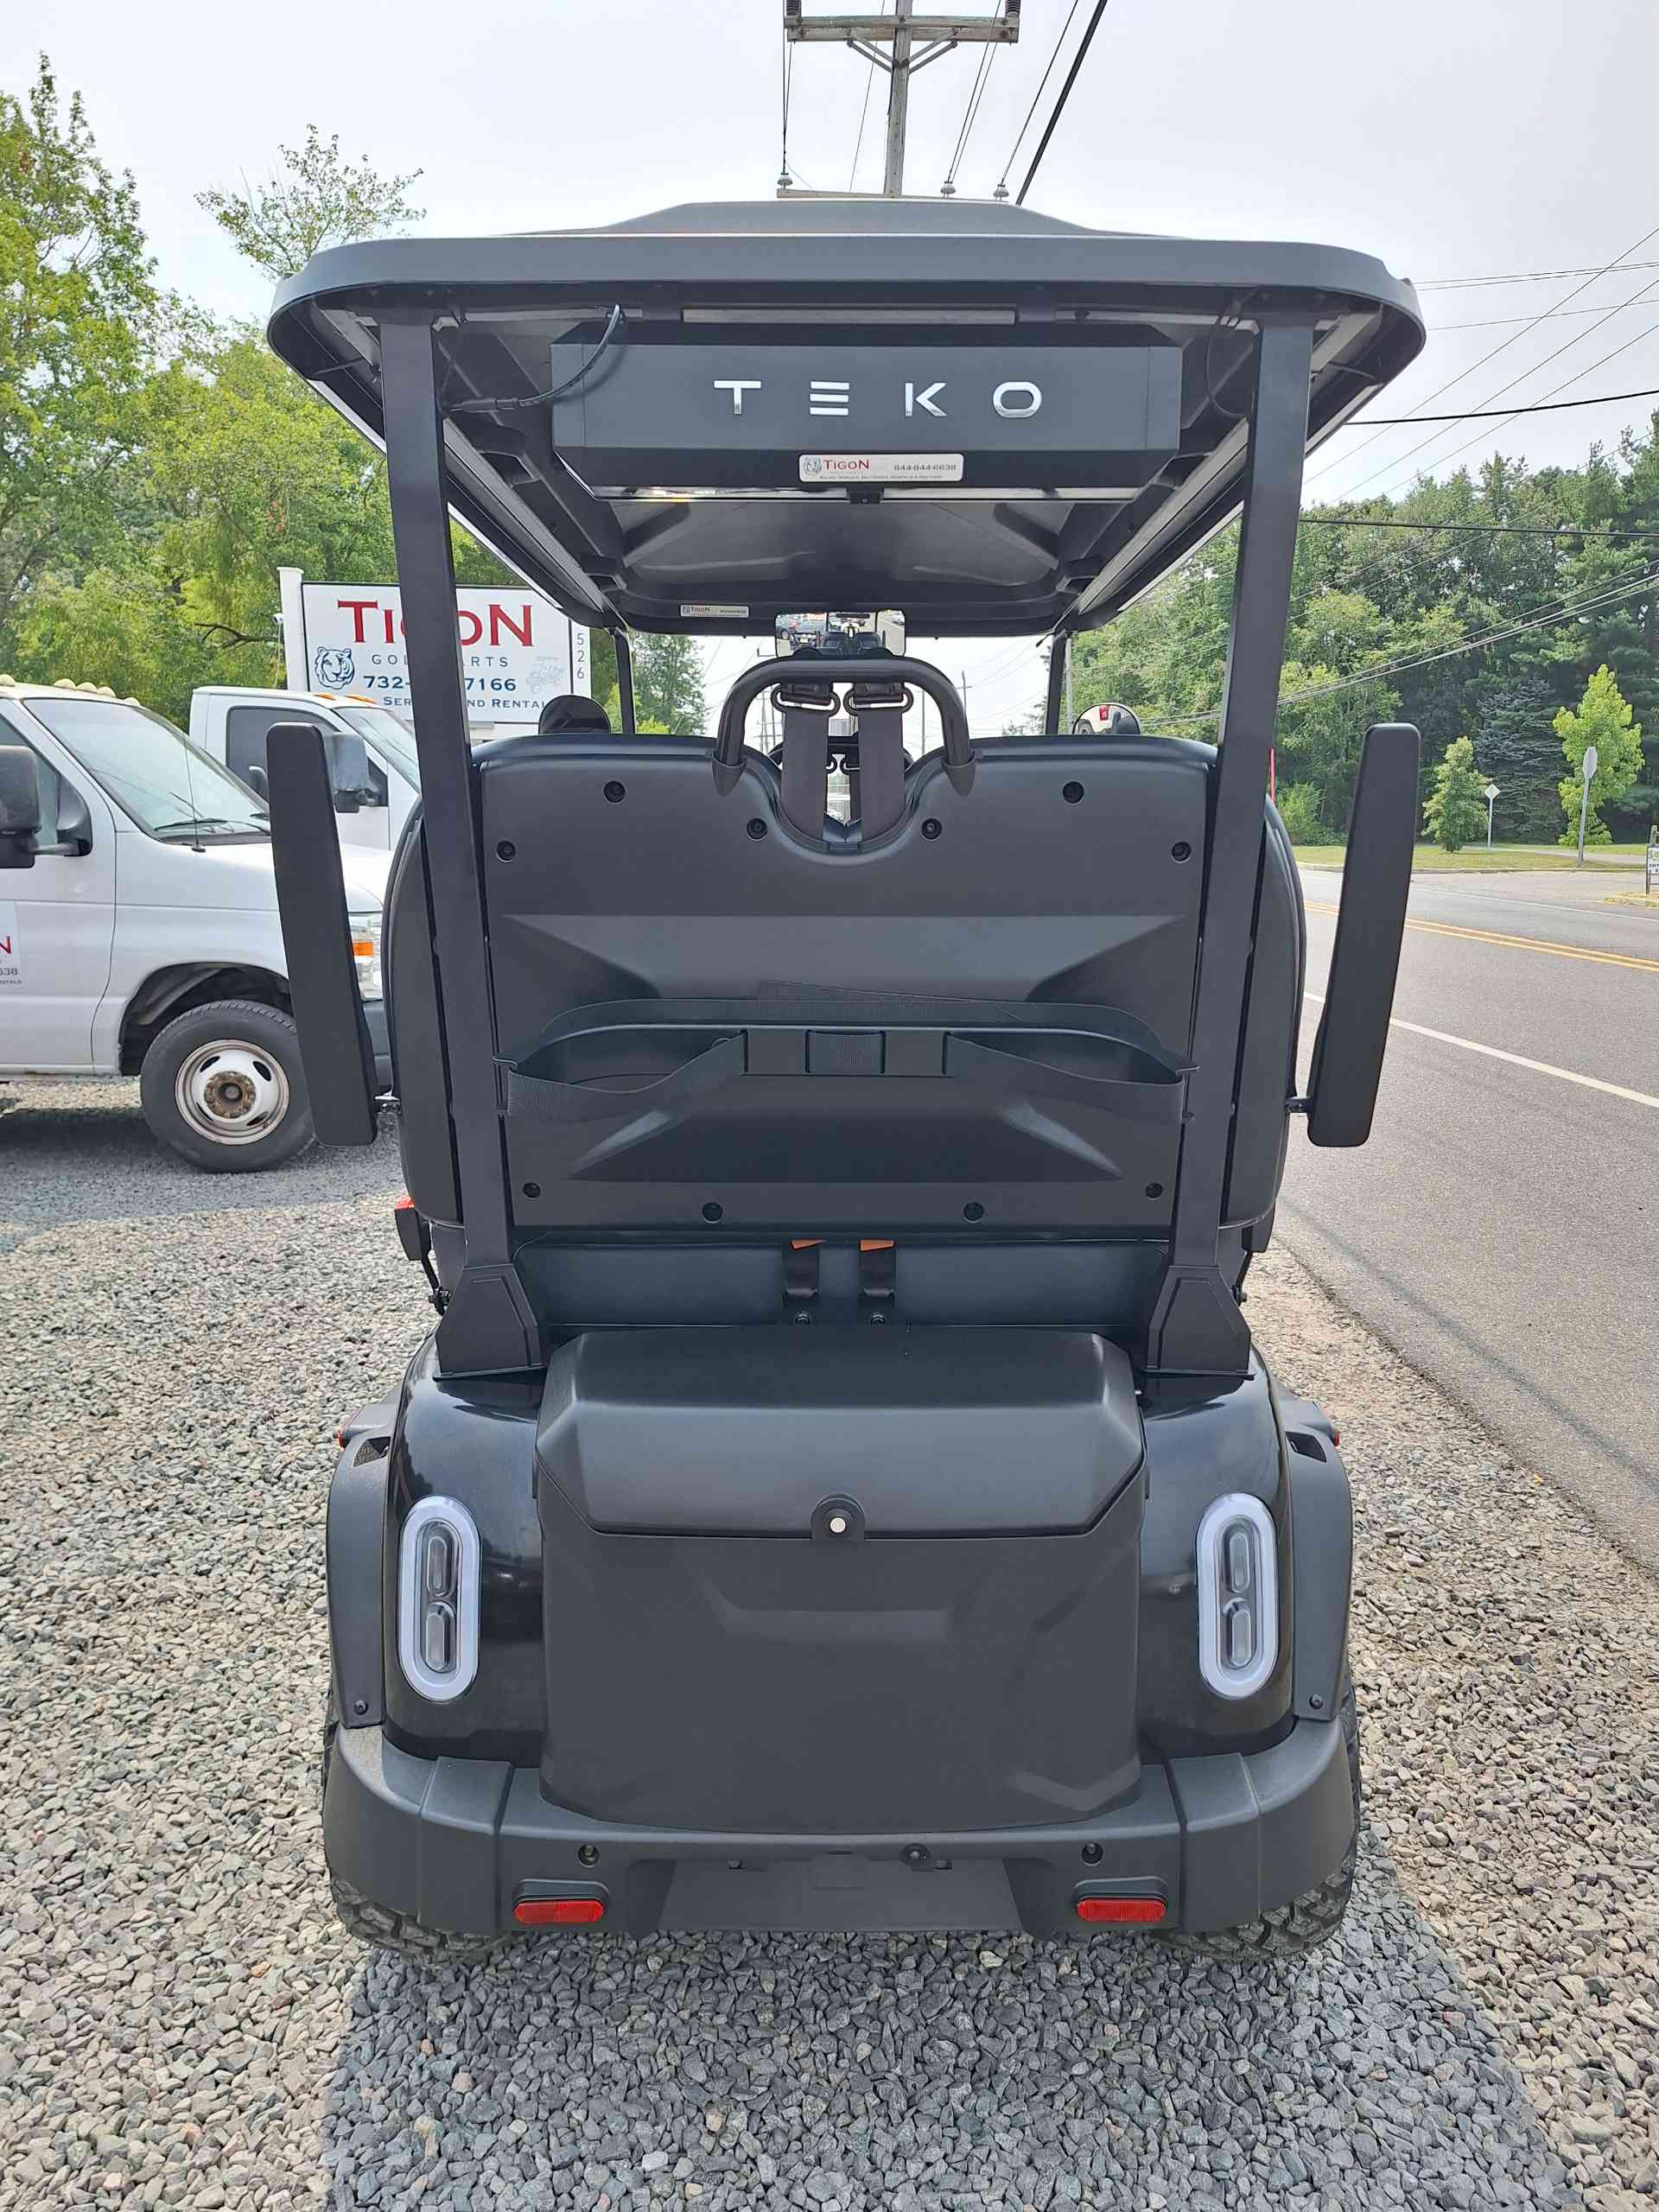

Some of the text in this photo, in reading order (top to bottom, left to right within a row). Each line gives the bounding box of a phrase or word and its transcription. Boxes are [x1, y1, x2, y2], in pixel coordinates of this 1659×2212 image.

[713, 379, 1042, 419] TEKO
[823, 459, 870, 470] TIGON
[337, 600, 534, 647] TION
[372, 654, 409, 665] GOL
[467, 699, 486, 708] ND
